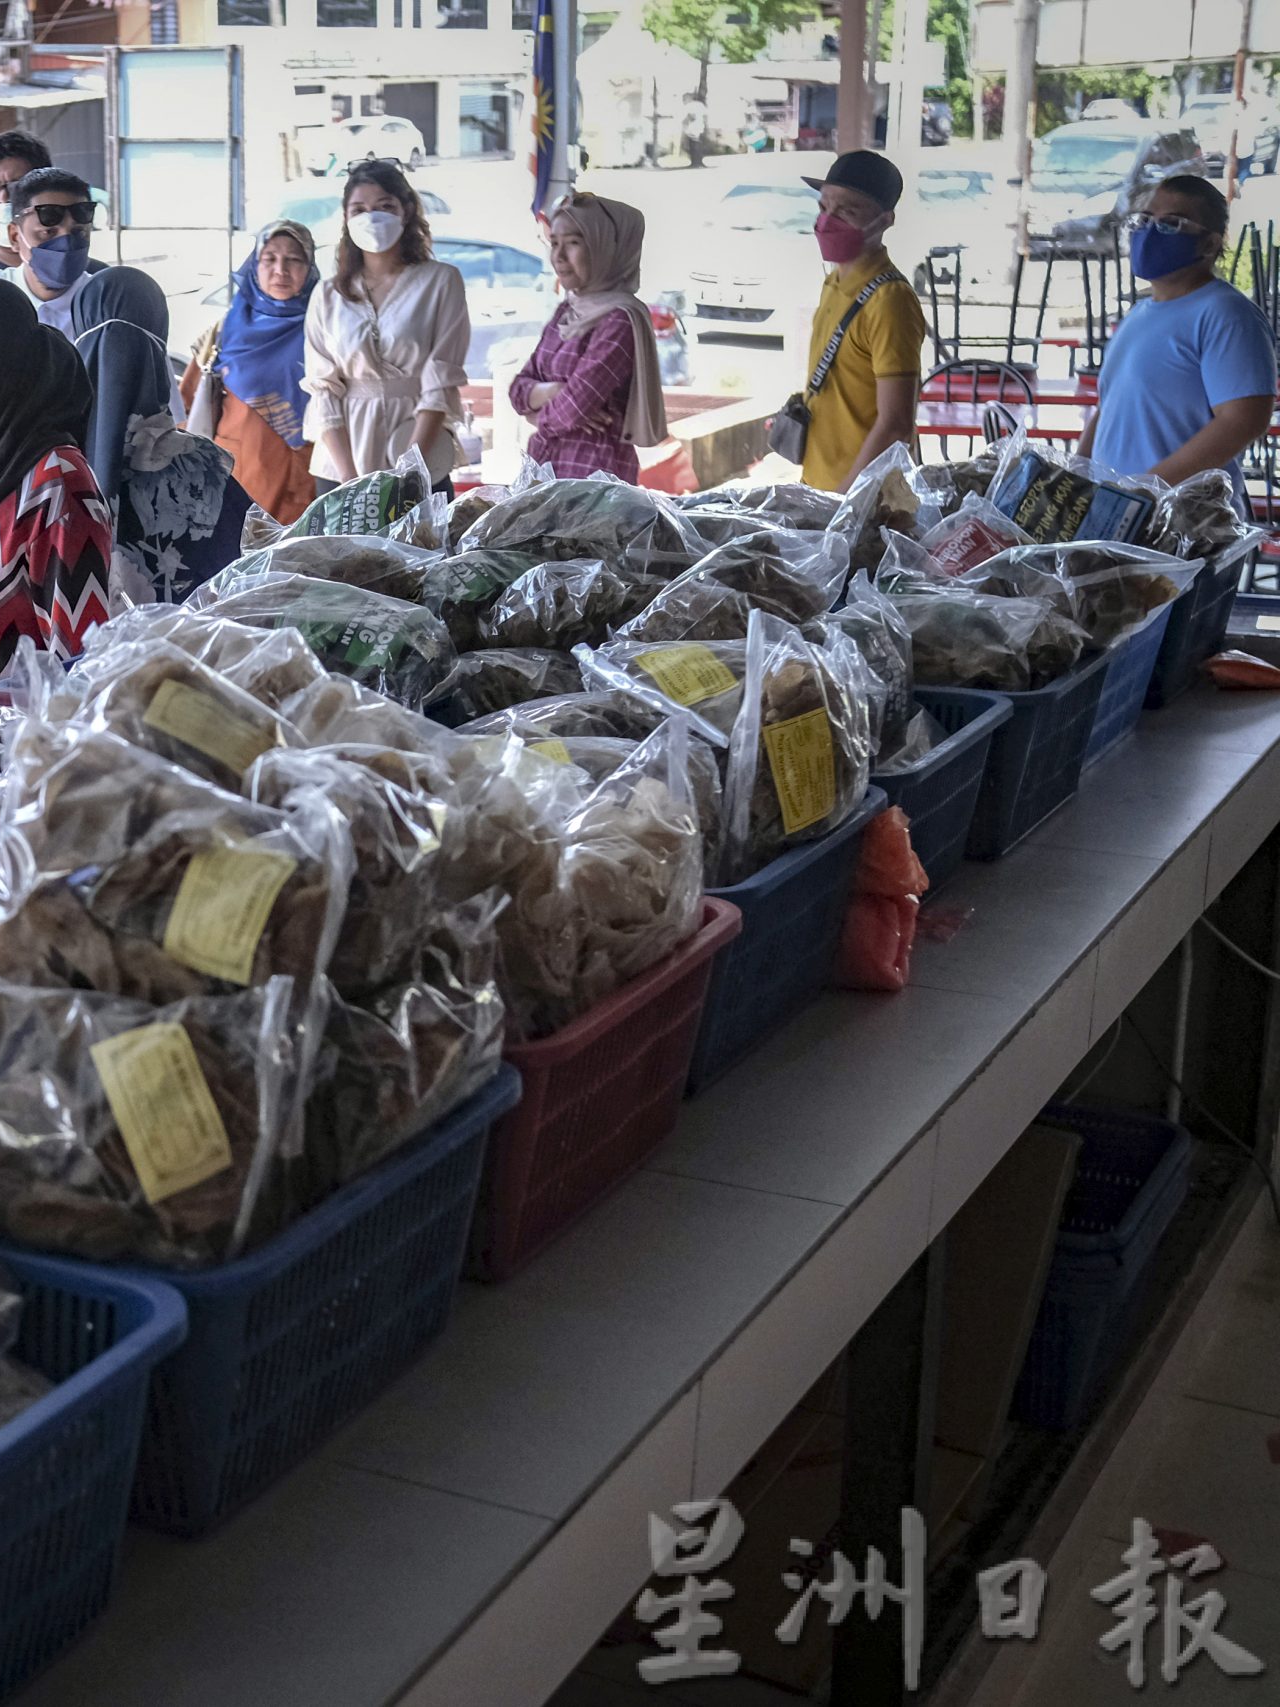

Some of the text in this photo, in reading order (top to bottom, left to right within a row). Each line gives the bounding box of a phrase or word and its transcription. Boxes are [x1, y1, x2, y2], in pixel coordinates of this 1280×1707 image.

[810, 324, 844, 387] GREGORY
[1032, 476, 1075, 543] EPING IKAN
